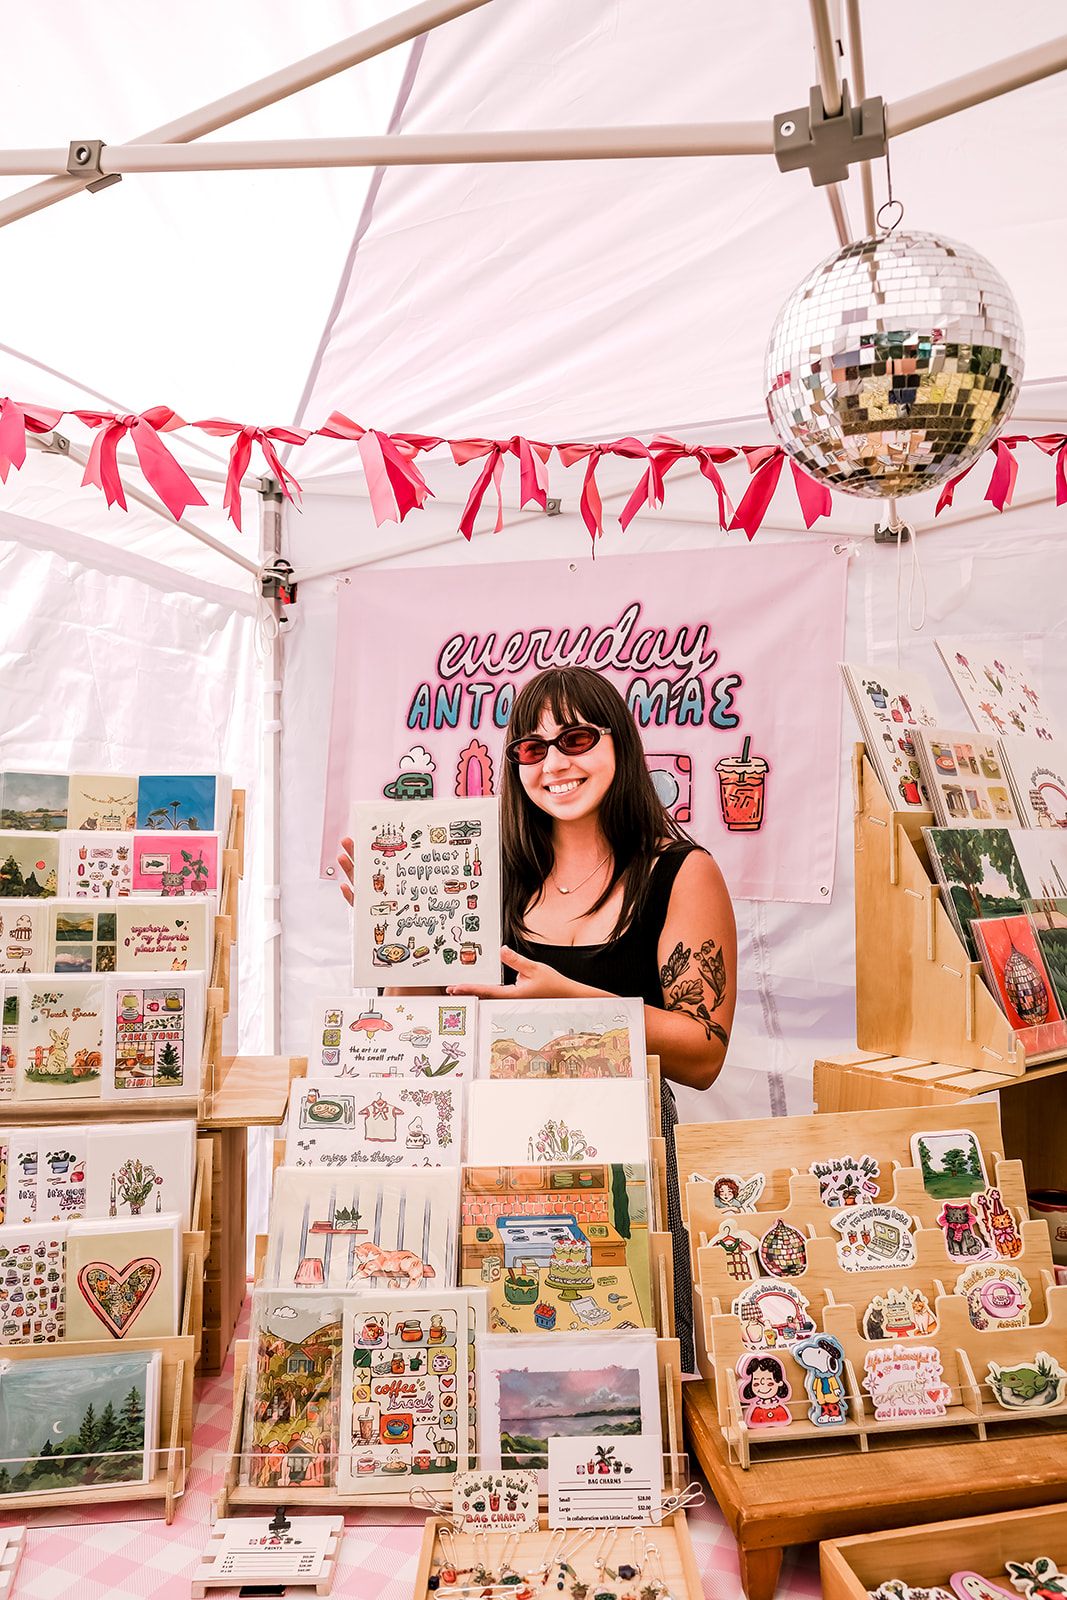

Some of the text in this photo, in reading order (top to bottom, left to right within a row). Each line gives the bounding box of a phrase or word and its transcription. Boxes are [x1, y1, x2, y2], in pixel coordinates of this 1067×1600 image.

[437, 601, 718, 709] everyday
[406, 673, 743, 730] ANTO MAE
[421, 848, 459, 863] what
[396, 863, 459, 881] happens
[396, 880, 439, 901] if you
[396, 913, 447, 936] going?
[40, 1008, 97, 1021] Touch Grass
[121, 1031, 180, 1041] TAKE YOUR
[349, 1045, 360, 1053] the
[354, 1053, 365, 1061] the
[386, 1053, 404, 1061] stuff
[320, 1150, 404, 1167] enjoy the things
[813, 1157, 878, 1179] this is the life
[999, 1268, 1017, 1281] you
[374, 1380, 434, 1411] coffee break
[464, 1475, 528, 1498] one of a kind
[466, 1512, 526, 1523] BAG CHARM
